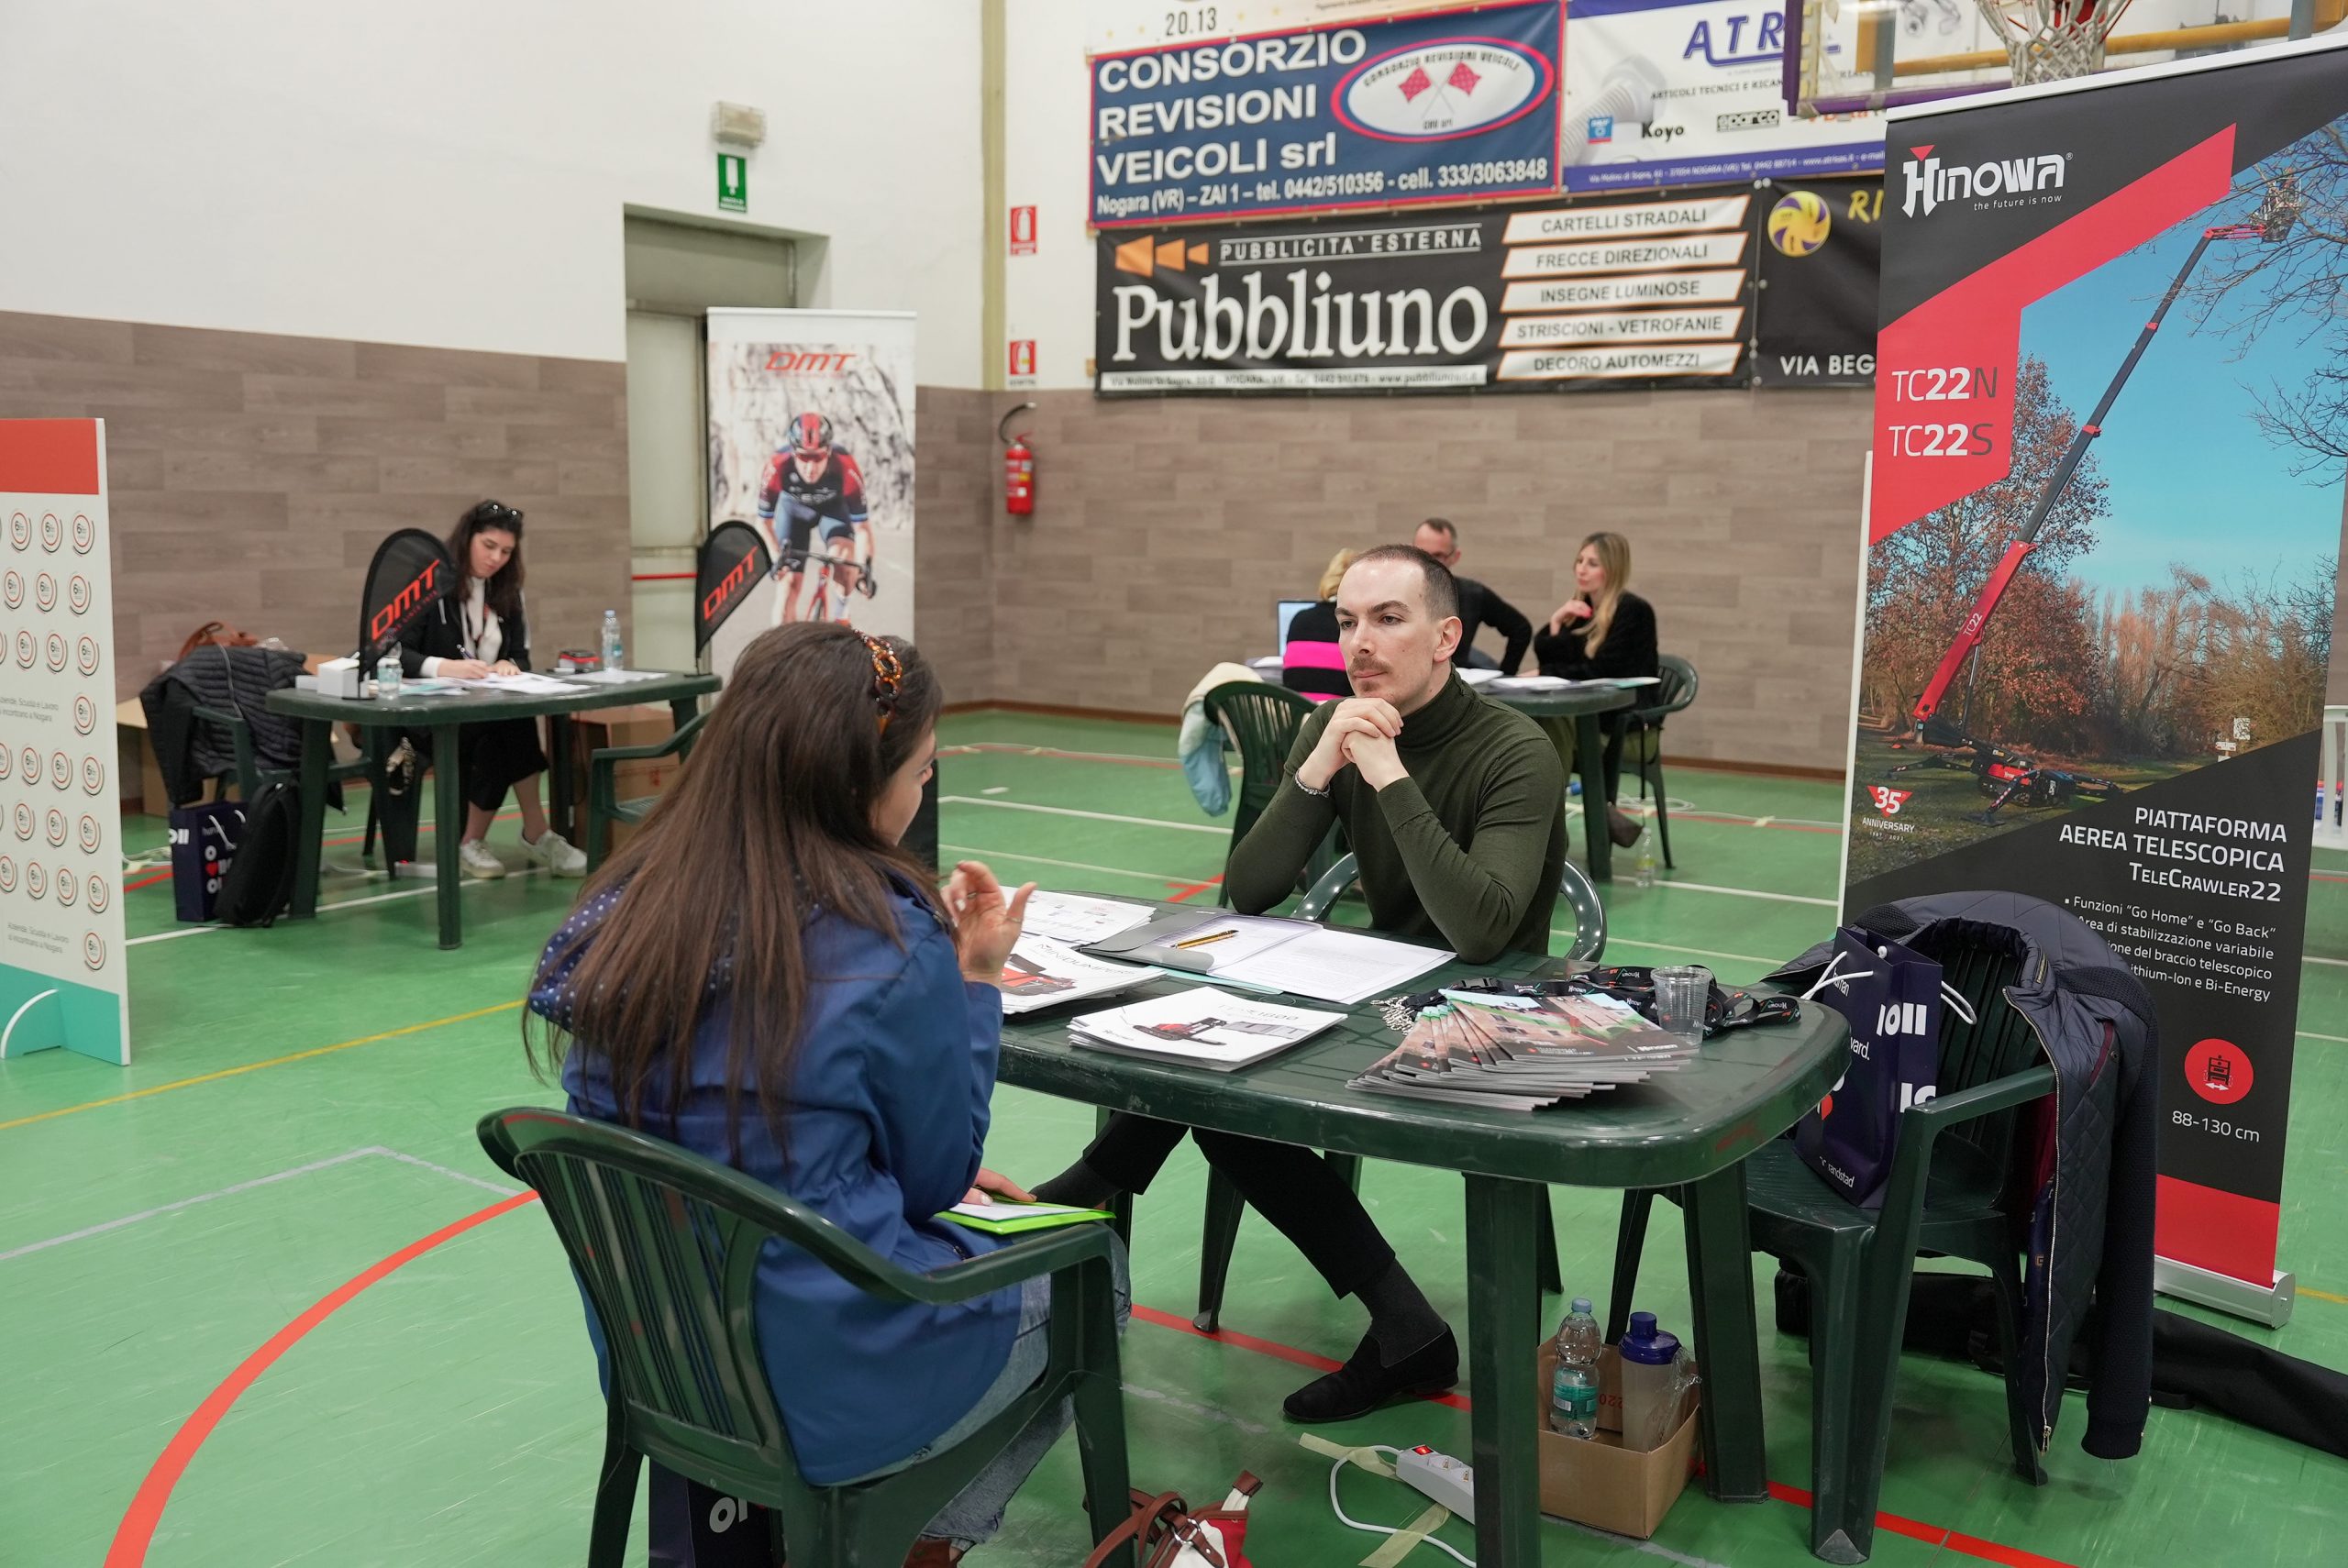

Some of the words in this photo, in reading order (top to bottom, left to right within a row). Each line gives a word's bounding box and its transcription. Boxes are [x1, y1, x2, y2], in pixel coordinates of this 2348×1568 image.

[1166, 7, 1217, 36] 20.13
[1099, 28, 1367, 93] CONSORZIO
[1099, 84, 1317, 140] REVISIONI
[1642, 120, 1684, 142] Koyo
[1096, 141, 1267, 186] VEICOLI
[1280, 132, 1337, 169] srl
[1097, 194, 1149, 218] Nogara
[1152, 188, 1185, 214] (VR)
[1199, 184, 1227, 206] ZAI
[1230, 183, 1239, 204] 1
[1256, 181, 1281, 202] tel.
[1284, 171, 1384, 200] 0442/510356
[1398, 166, 1434, 191] cell.
[1437, 157, 1548, 189] 333/3063848
[1974, 200, 1989, 212] the
[1993, 197, 2025, 209] future
[2028, 194, 2037, 205] is
[2041, 194, 2063, 204] now
[1542, 215, 1619, 235] CARTELLI
[1623, 208, 1707, 228] STRADALI
[1370, 227, 1483, 253] ESTERNA
[1536, 249, 1600, 269] FRECCE
[1604, 244, 1709, 266] DIREZIONALI
[1540, 284, 1611, 304] INSEGNE
[1614, 281, 1700, 301] LUMINOSE
[1112, 268, 1489, 361] Pubbliuno
[1517, 320, 1604, 339] STRISCIONI
[1618, 315, 1723, 334] VETROFANIE
[1534, 354, 1601, 372] DECORO
[1605, 352, 1700, 370] AUTOMEZZI
[1780, 355, 1824, 377] VIA
[1829, 353, 1876, 375] BEG
[1891, 366, 1998, 402] TC22N
[1888, 423, 1994, 457] TC22S
[1962, 613, 1983, 636] TC22
[1874, 786, 1901, 814] 35
[1862, 816, 1915, 834] ANNIVERSARY
[2134, 807, 2287, 843] PIATTAFORMA
[2059, 823, 2128, 851] AEREA
[2133, 834, 2285, 873] TELESCOPICA
[2074, 896, 2123, 915] Funzioni
[2197, 919, 2205, 929] e
[2107, 921, 2119, 933] di
[2121, 923, 2212, 950] stabilizzazione
[2216, 942, 2275, 960] variabile
[2134, 946, 2153, 959] del
[2154, 949, 2197, 967] braccio
[2199, 958, 2273, 980] telescopico
[2195, 977, 2203, 988] e
[2205, 978, 2271, 1002] Bi-Energy
[2172, 1110, 2232, 1136] 88-130
[2235, 1127, 2260, 1143] cm
[1828, 1164, 1855, 1188] randstad
